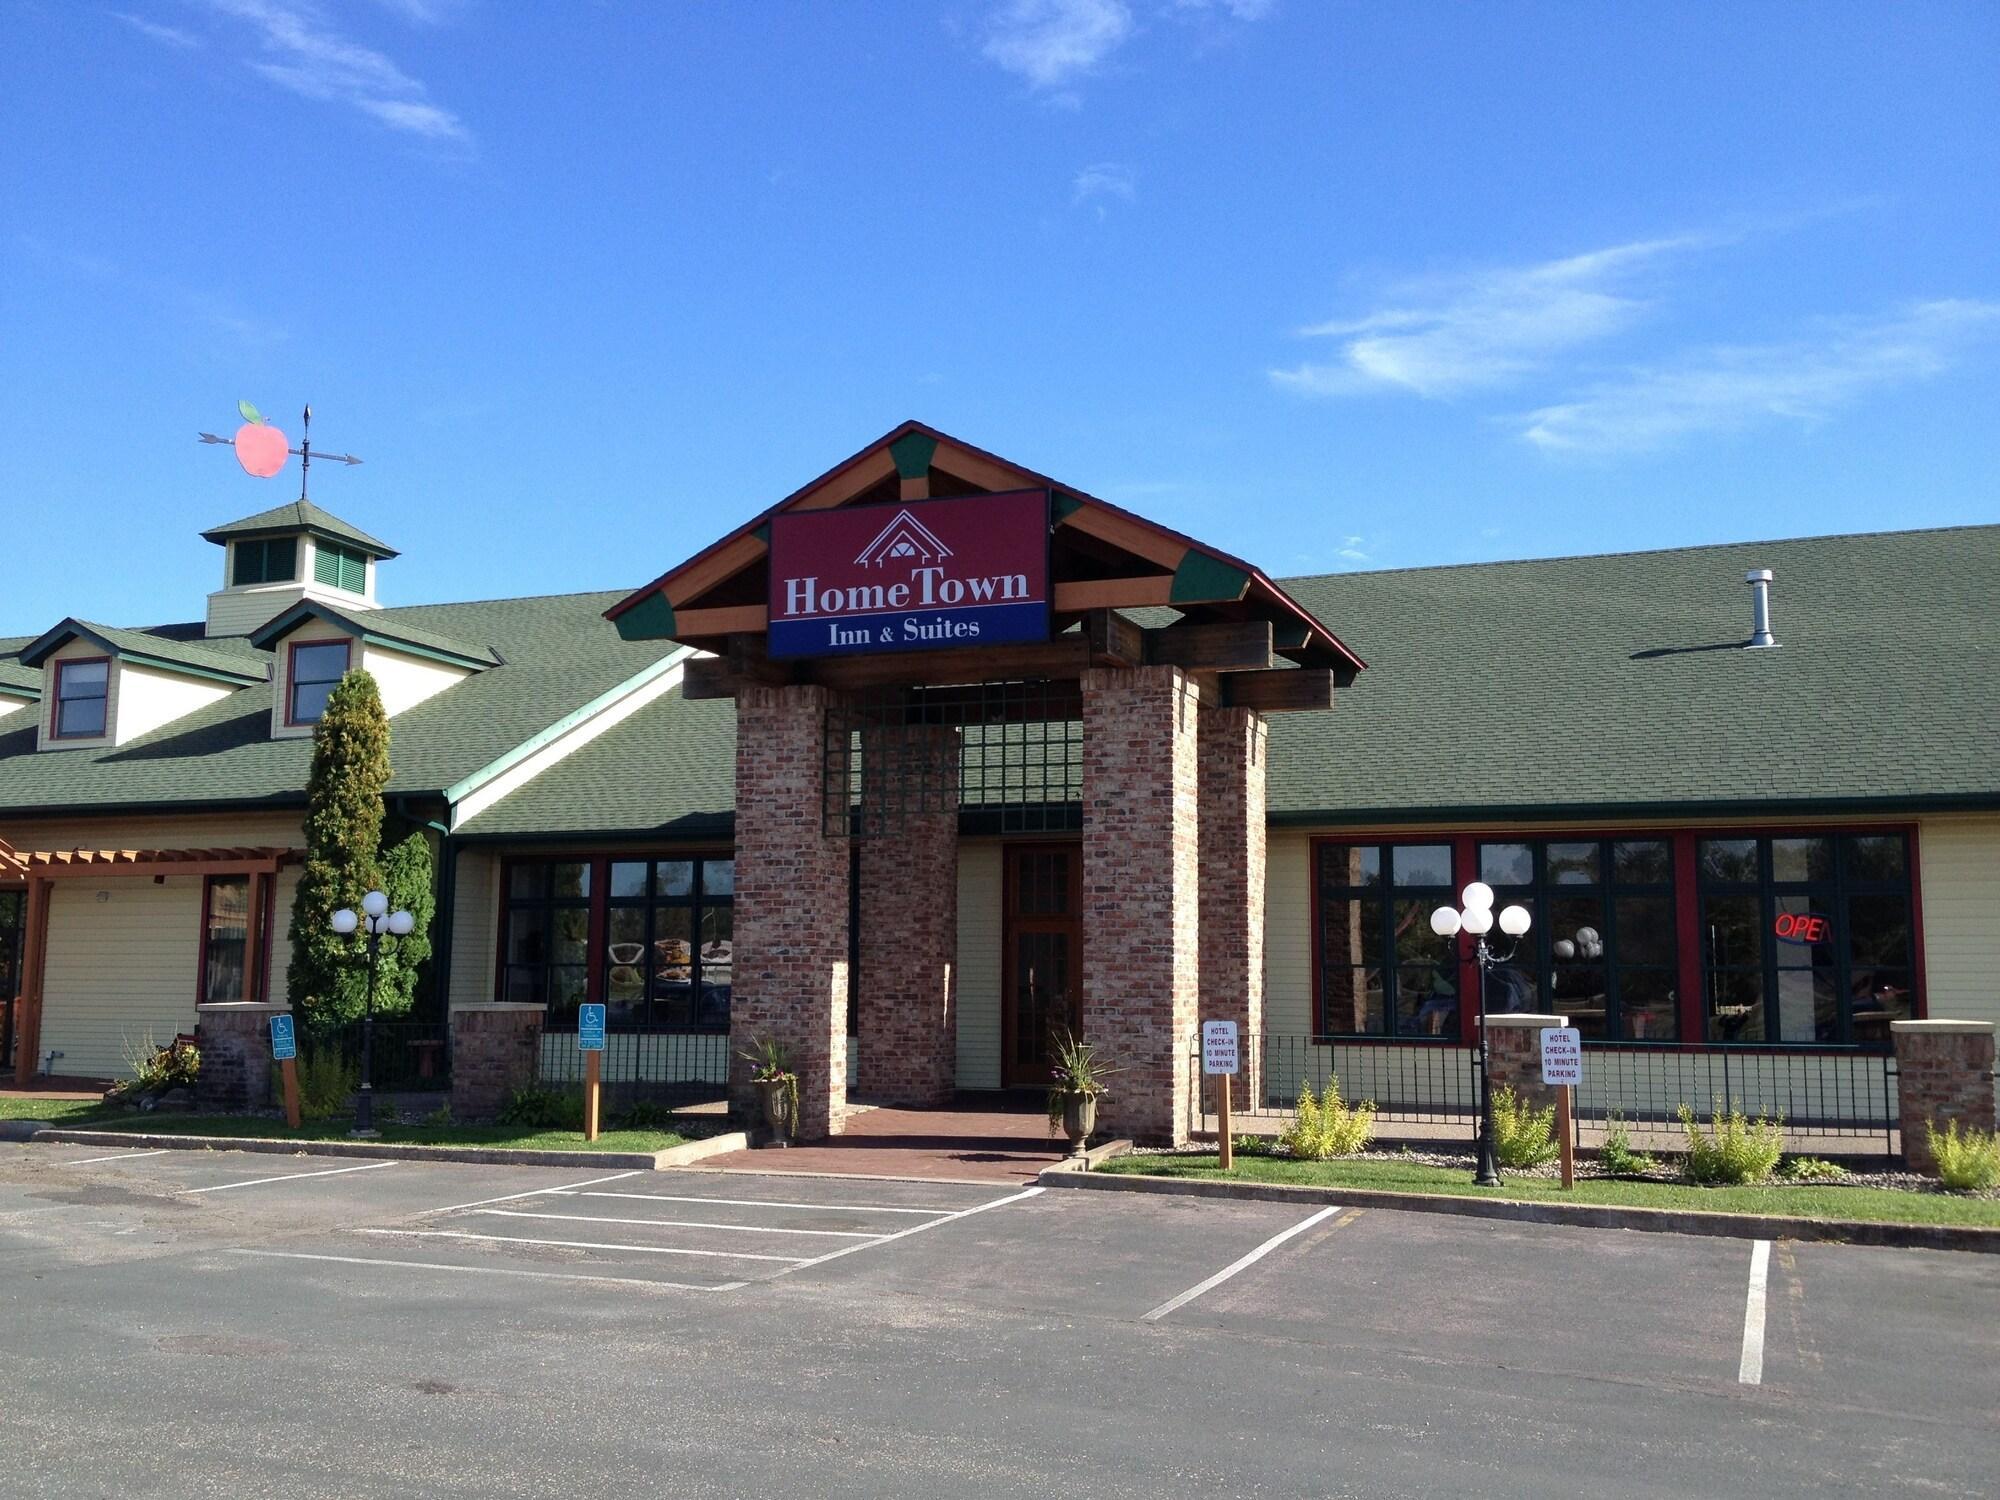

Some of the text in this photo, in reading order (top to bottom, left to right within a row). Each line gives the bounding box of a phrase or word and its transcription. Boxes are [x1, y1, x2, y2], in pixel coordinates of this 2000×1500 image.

[783, 567, 1030, 615] HomeTown
[829, 617, 980, 646] Inn & Suites
